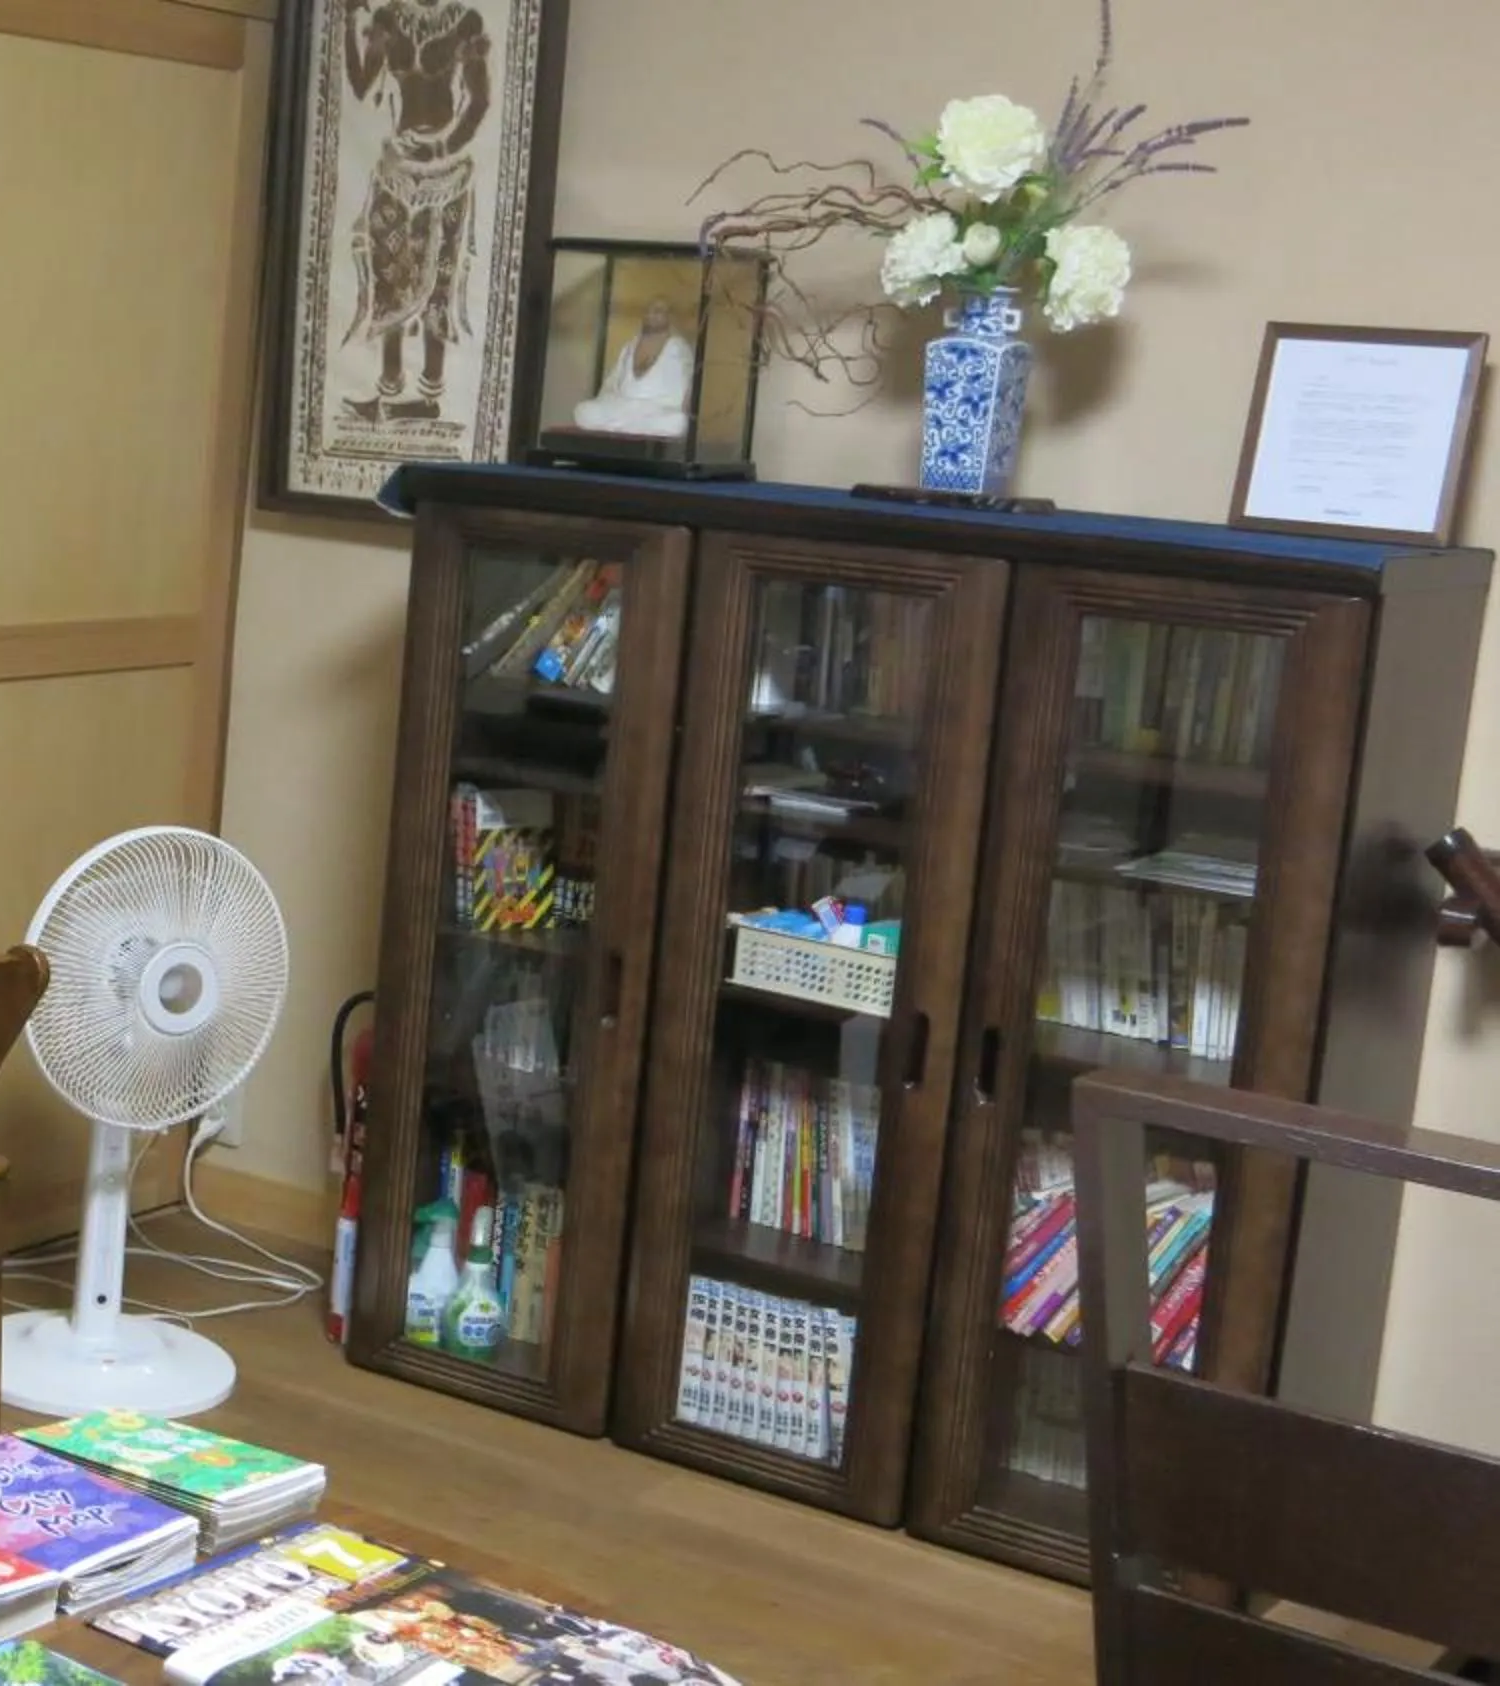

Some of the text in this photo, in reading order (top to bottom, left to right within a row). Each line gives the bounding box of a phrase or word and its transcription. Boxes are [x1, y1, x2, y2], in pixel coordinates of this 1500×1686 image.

[35, 1503, 114, 1538] Map
[298, 1538, 364, 1570] 7
[106, 1554, 313, 1648] KYOTO
